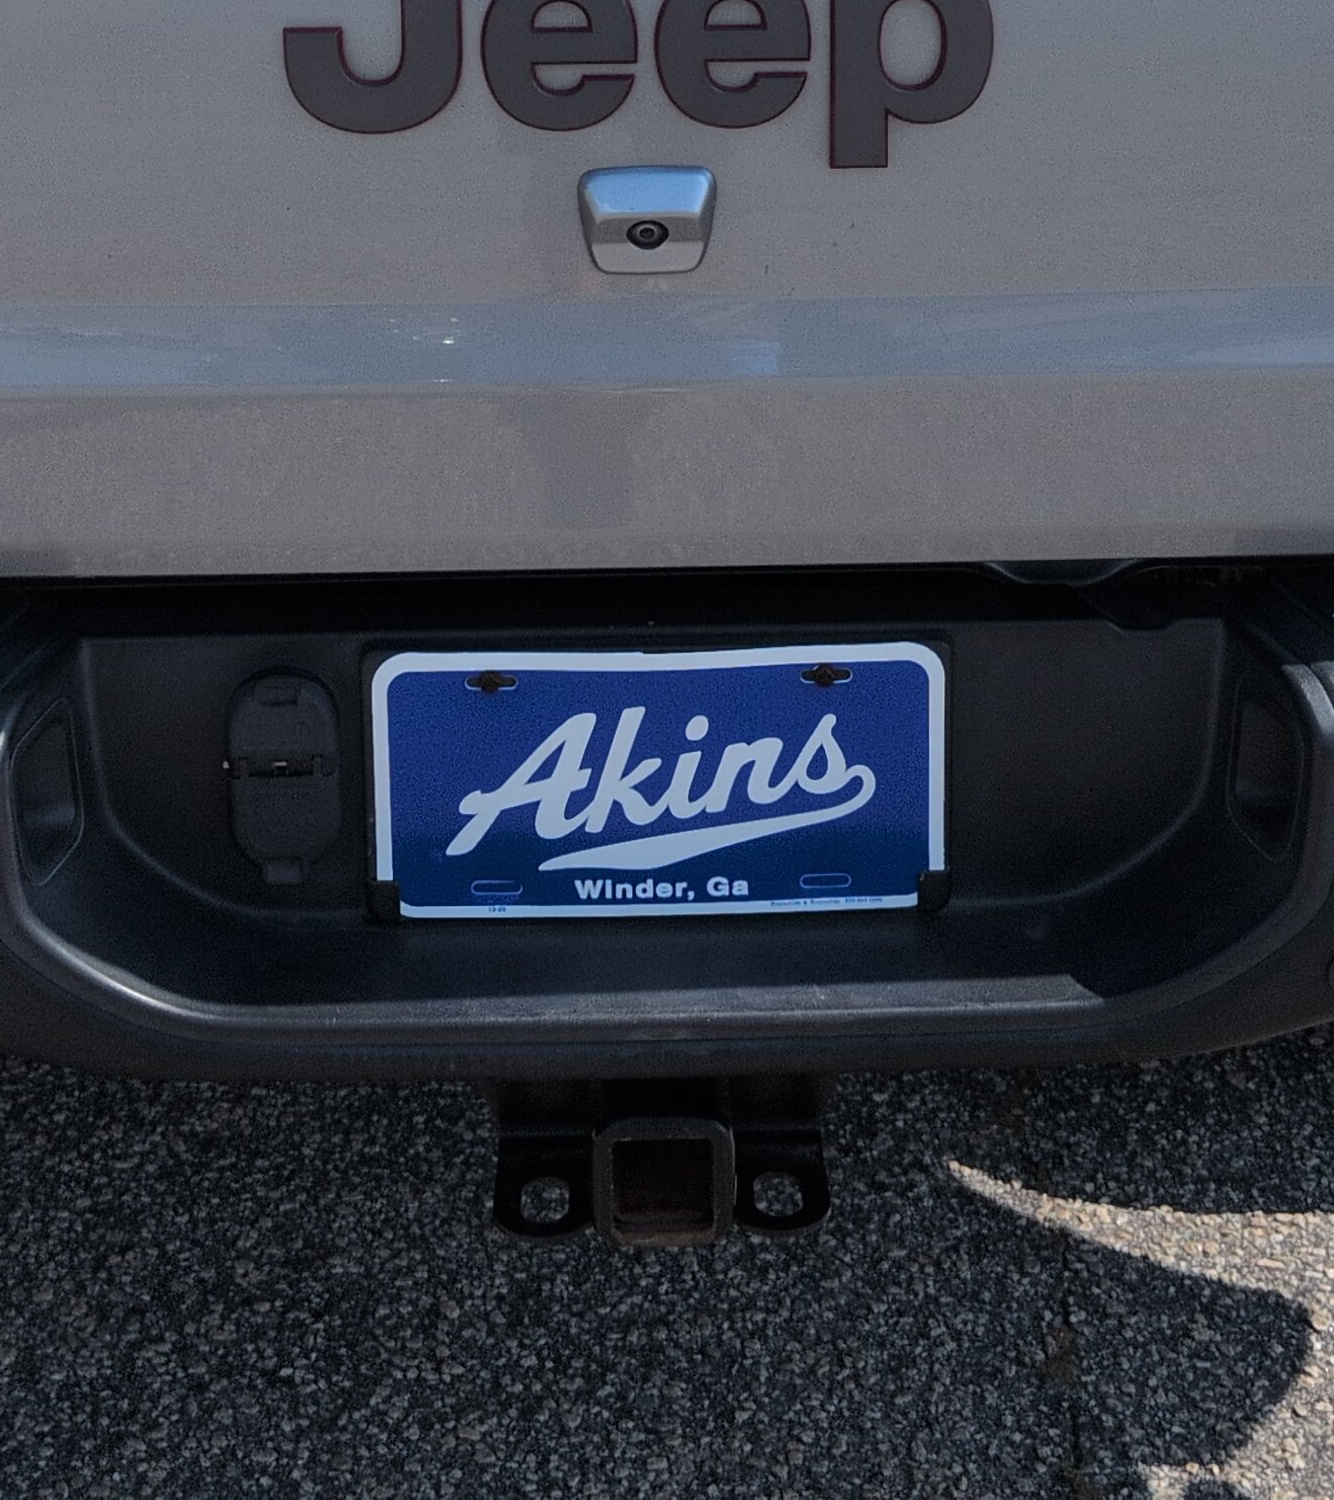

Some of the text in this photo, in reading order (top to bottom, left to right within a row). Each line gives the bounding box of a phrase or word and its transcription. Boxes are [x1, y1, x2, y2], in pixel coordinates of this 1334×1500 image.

[445, 705, 876, 871] Akins
[574, 876, 750, 901] Winder, Ga
